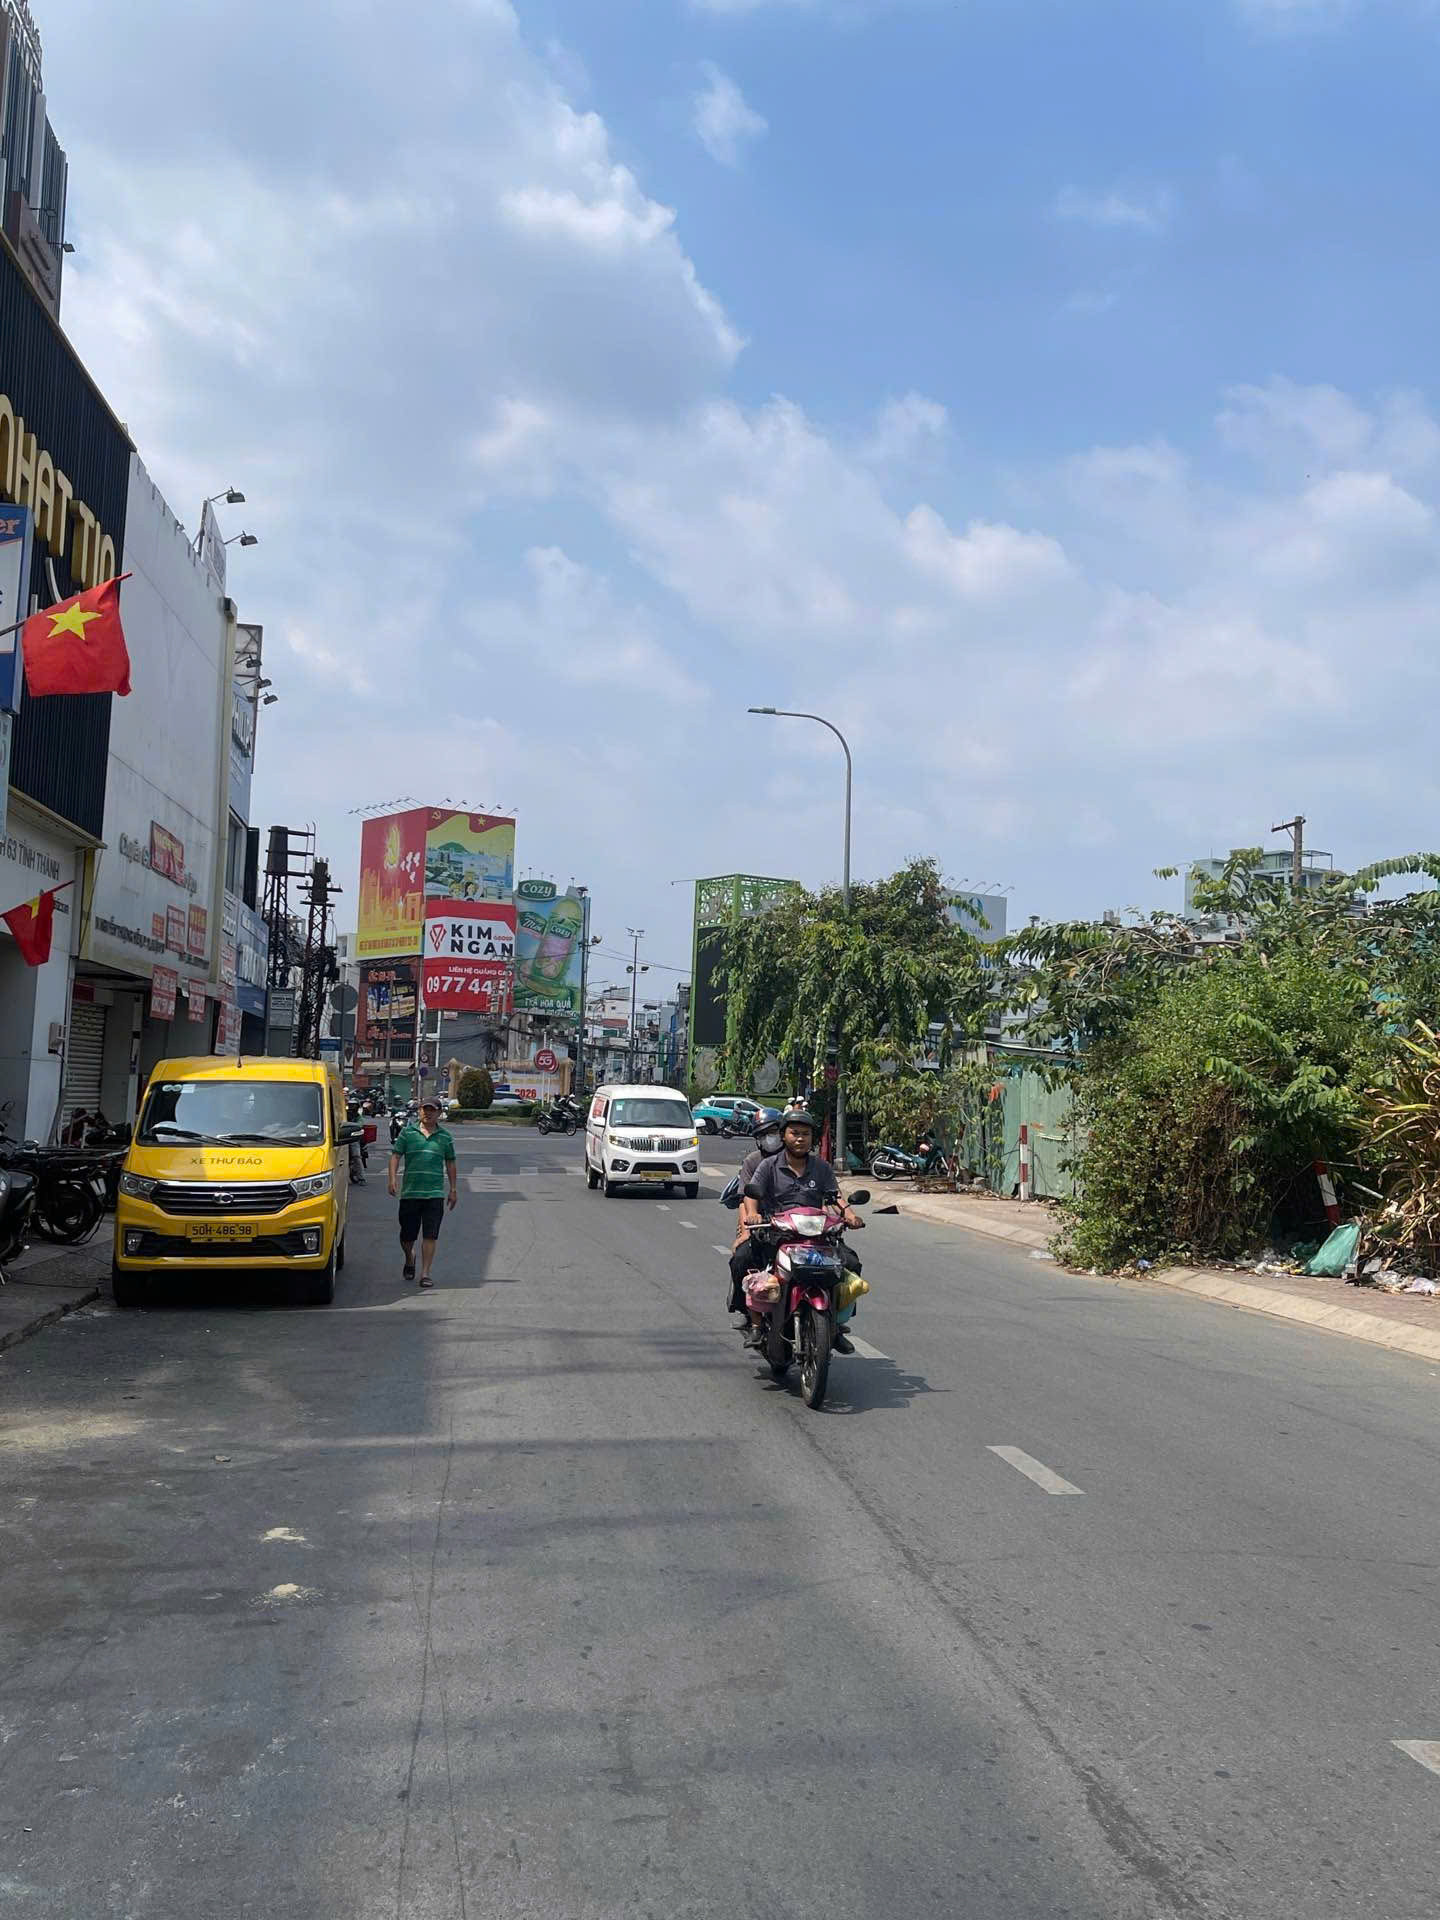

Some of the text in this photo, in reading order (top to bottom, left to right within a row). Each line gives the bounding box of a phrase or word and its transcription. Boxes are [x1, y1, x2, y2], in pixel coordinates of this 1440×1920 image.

[7, 838, 17, 860] 63
[521, 882, 552, 897] Cozy
[451, 924, 492, 940] KIM
[551, 925, 571, 938] Cozy
[450, 939, 513, 957] NGAN
[448, 965, 462, 973] LIÊN
[464, 966, 473, 974] HỆ
[540, 999, 554, 1008] HOA
[556, 997, 571, 1008] QUẢ
[538, 1055, 552, 1066] 5G
[191, 1157, 206, 1165] XE
[210, 1157, 236, 1165] THƯ
